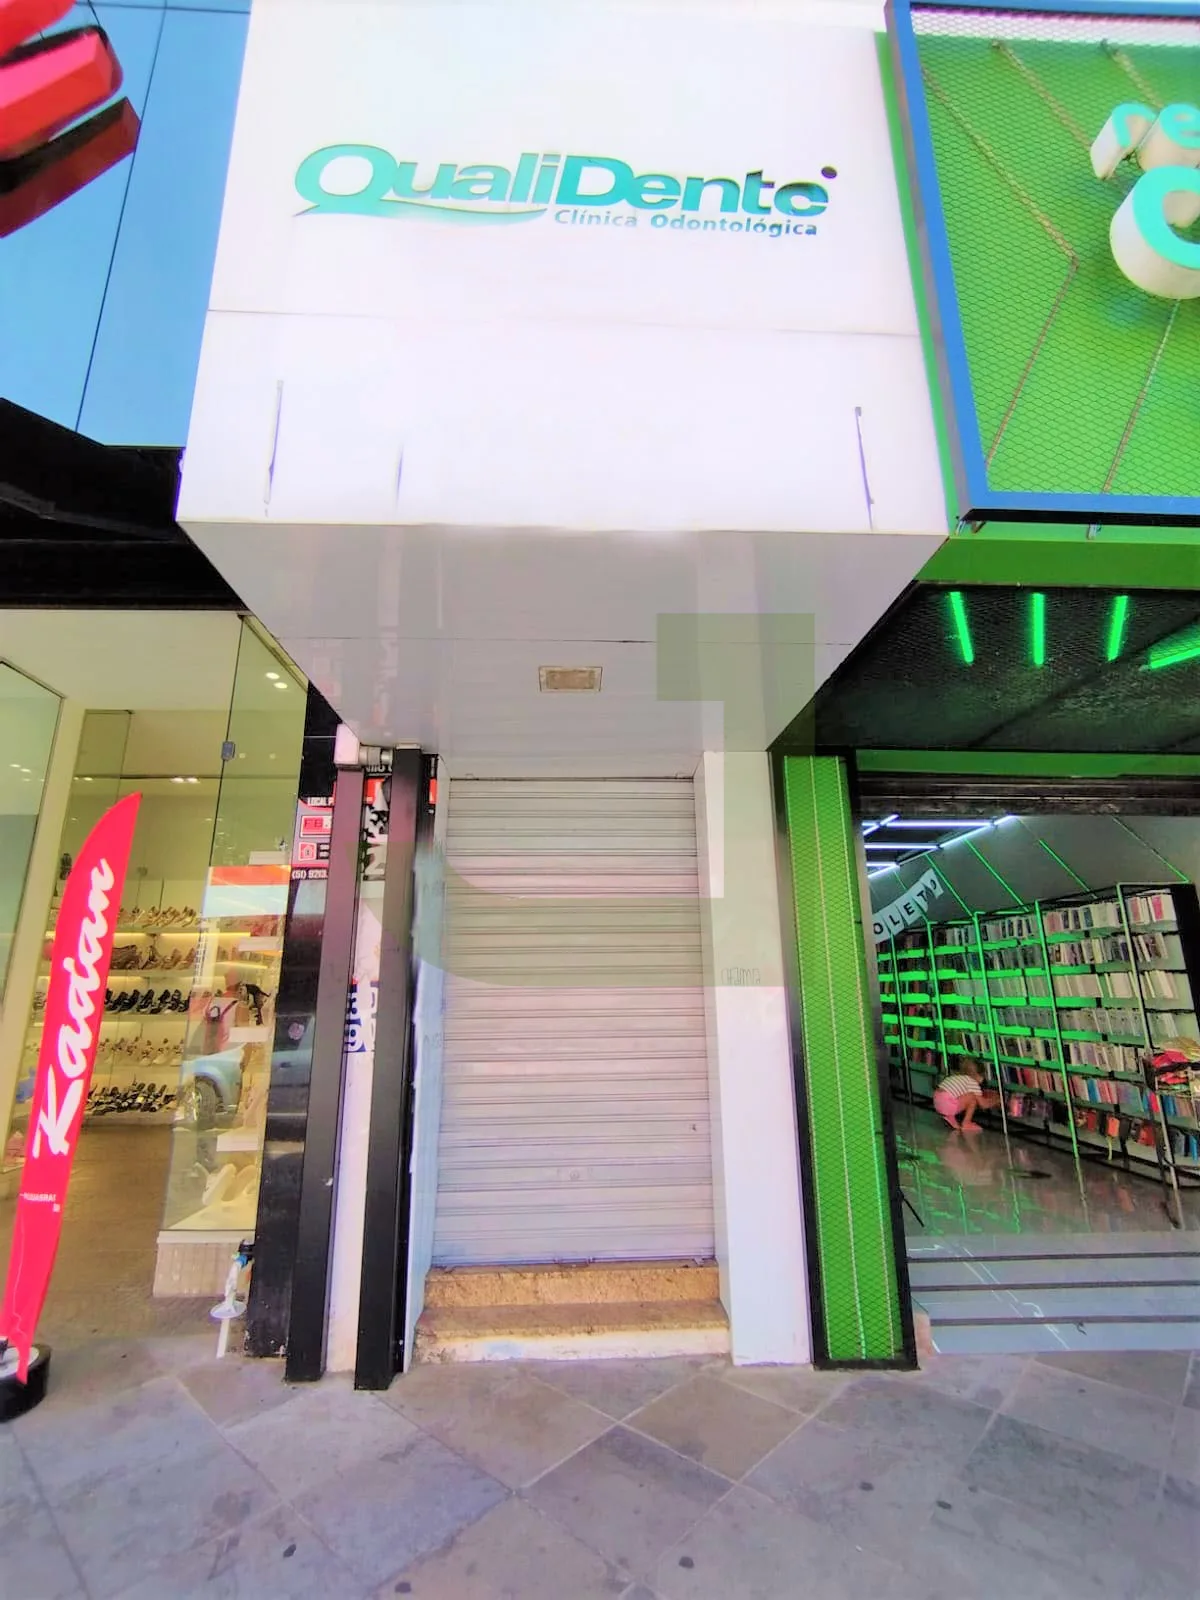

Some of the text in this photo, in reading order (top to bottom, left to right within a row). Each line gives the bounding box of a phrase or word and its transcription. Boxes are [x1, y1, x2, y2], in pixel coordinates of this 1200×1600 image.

[555, 208, 817, 238] Clínica Odontológica
[33, 857, 114, 1159] Kadan
